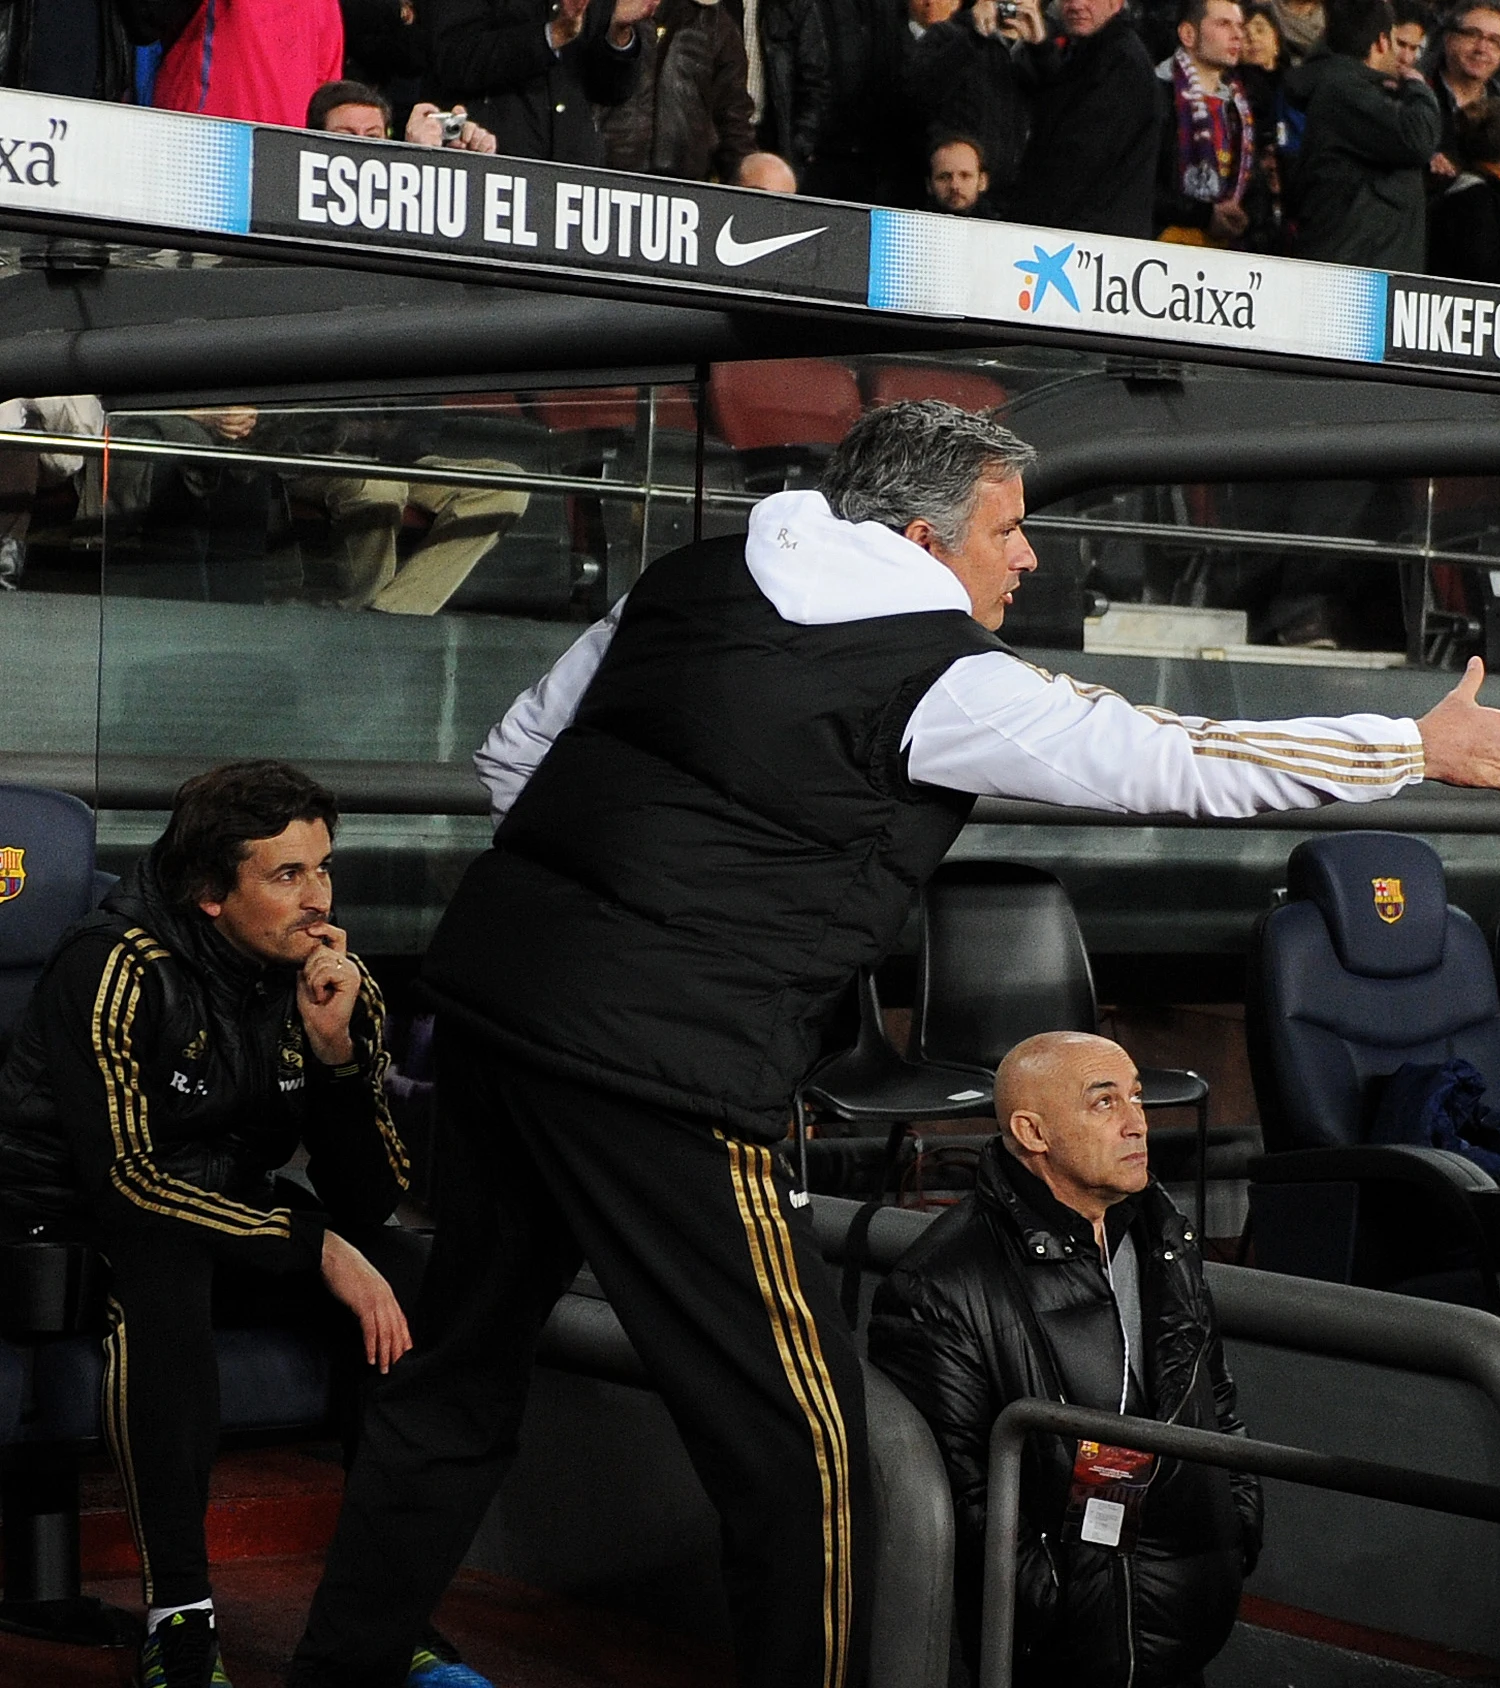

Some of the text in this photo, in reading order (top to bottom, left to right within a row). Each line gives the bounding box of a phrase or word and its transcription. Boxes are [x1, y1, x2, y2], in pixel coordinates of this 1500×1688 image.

[298, 150, 699, 266] ESCRIU EL FUTUR
